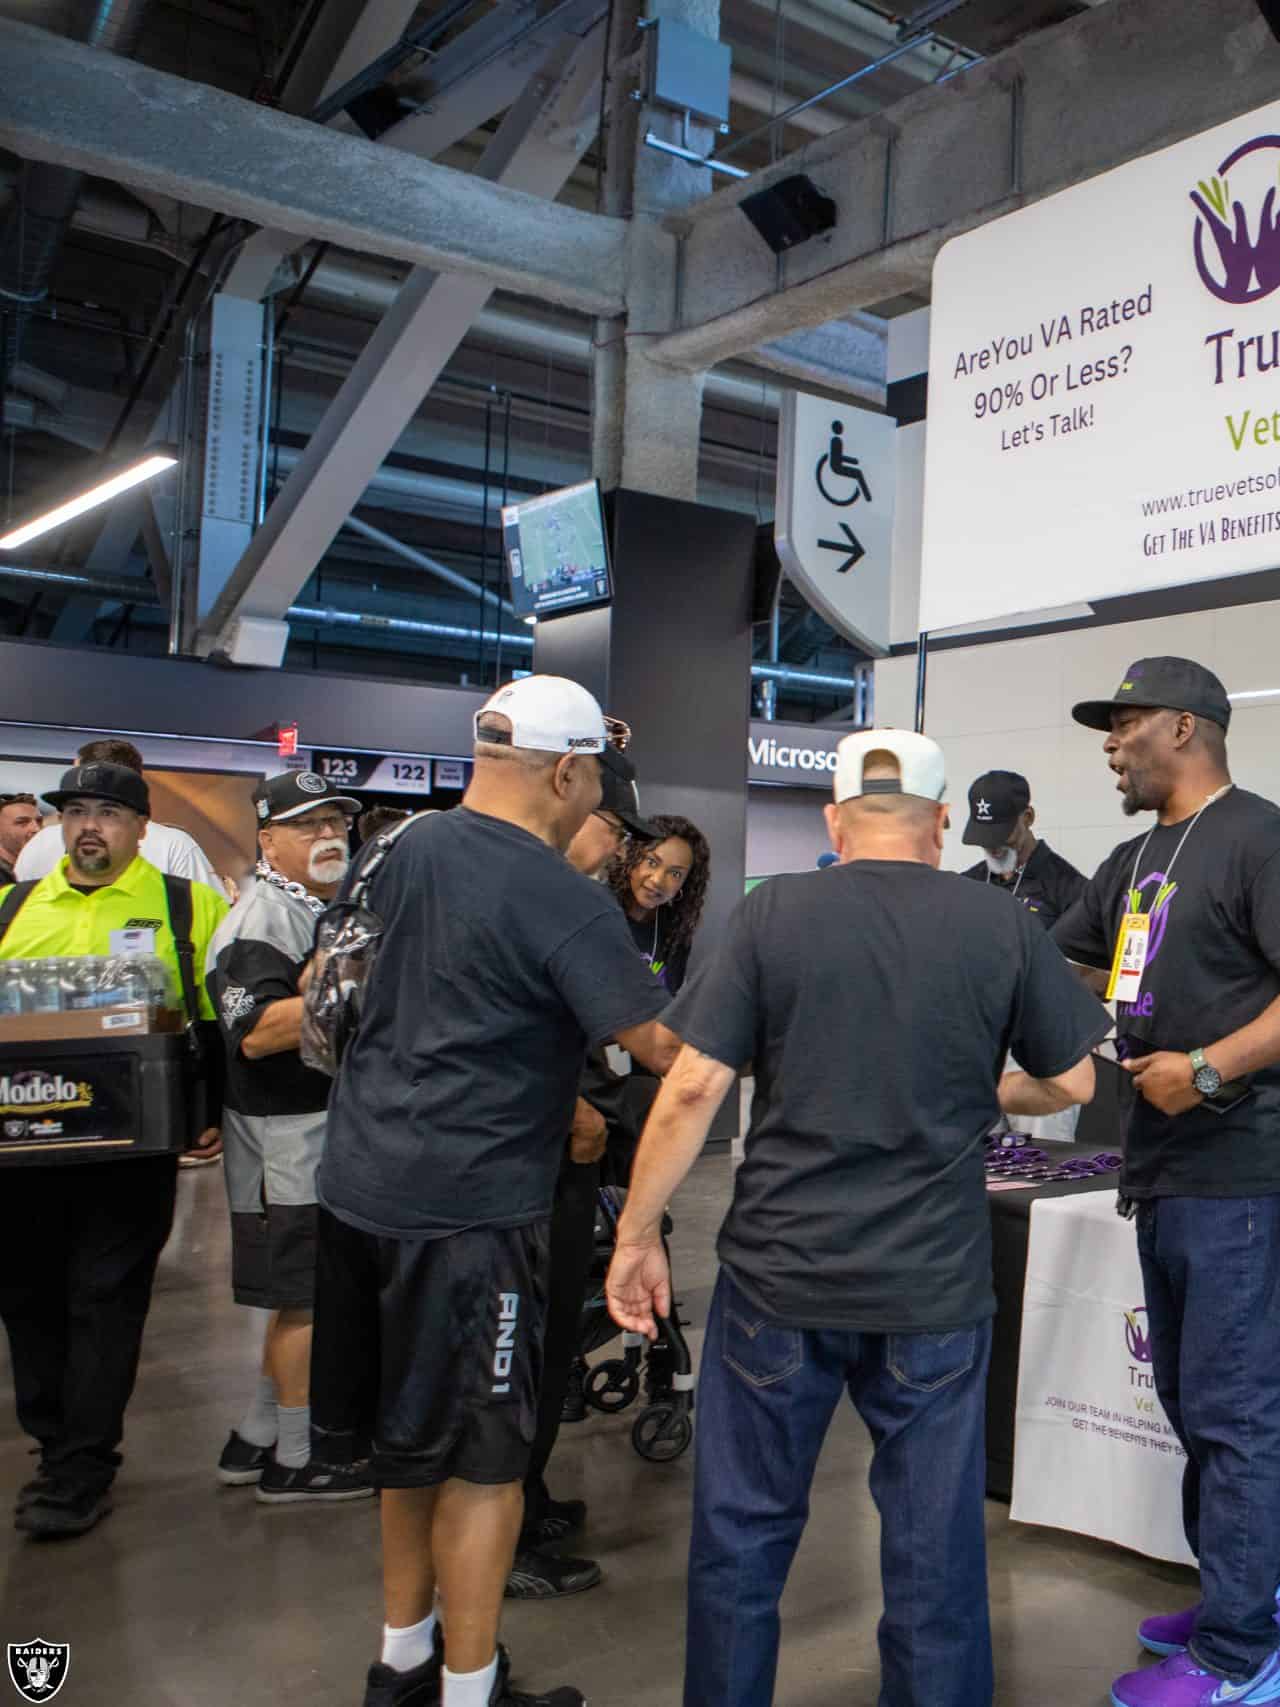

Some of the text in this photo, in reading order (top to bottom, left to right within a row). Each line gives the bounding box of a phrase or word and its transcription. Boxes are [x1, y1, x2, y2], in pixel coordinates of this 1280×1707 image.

[1039, 314, 1073, 349] VA
[1079, 283, 1153, 337] Rated
[973, 344, 1133, 420] 90% Or Less?
[1001, 403, 1095, 452] Let's Talk!
[1199, 519, 1217, 546] VA
[322, 758, 358, 777] 123
[747, 736, 840, 771] Microso
[392, 764, 426, 781] 122
[1128, 1366, 1154, 1389] Tru
[1045, 1396, 1066, 1409] JOIN
[1067, 1401, 1088, 1414] OUR
[1089, 1405, 1111, 1421] TEAM
[1112, 1410, 1122, 1423] IN
[1123, 1415, 1161, 1433] HELPING
[1072, 1418, 1089, 1433] GET
[1149, 1439, 1173, 1454] THEY
